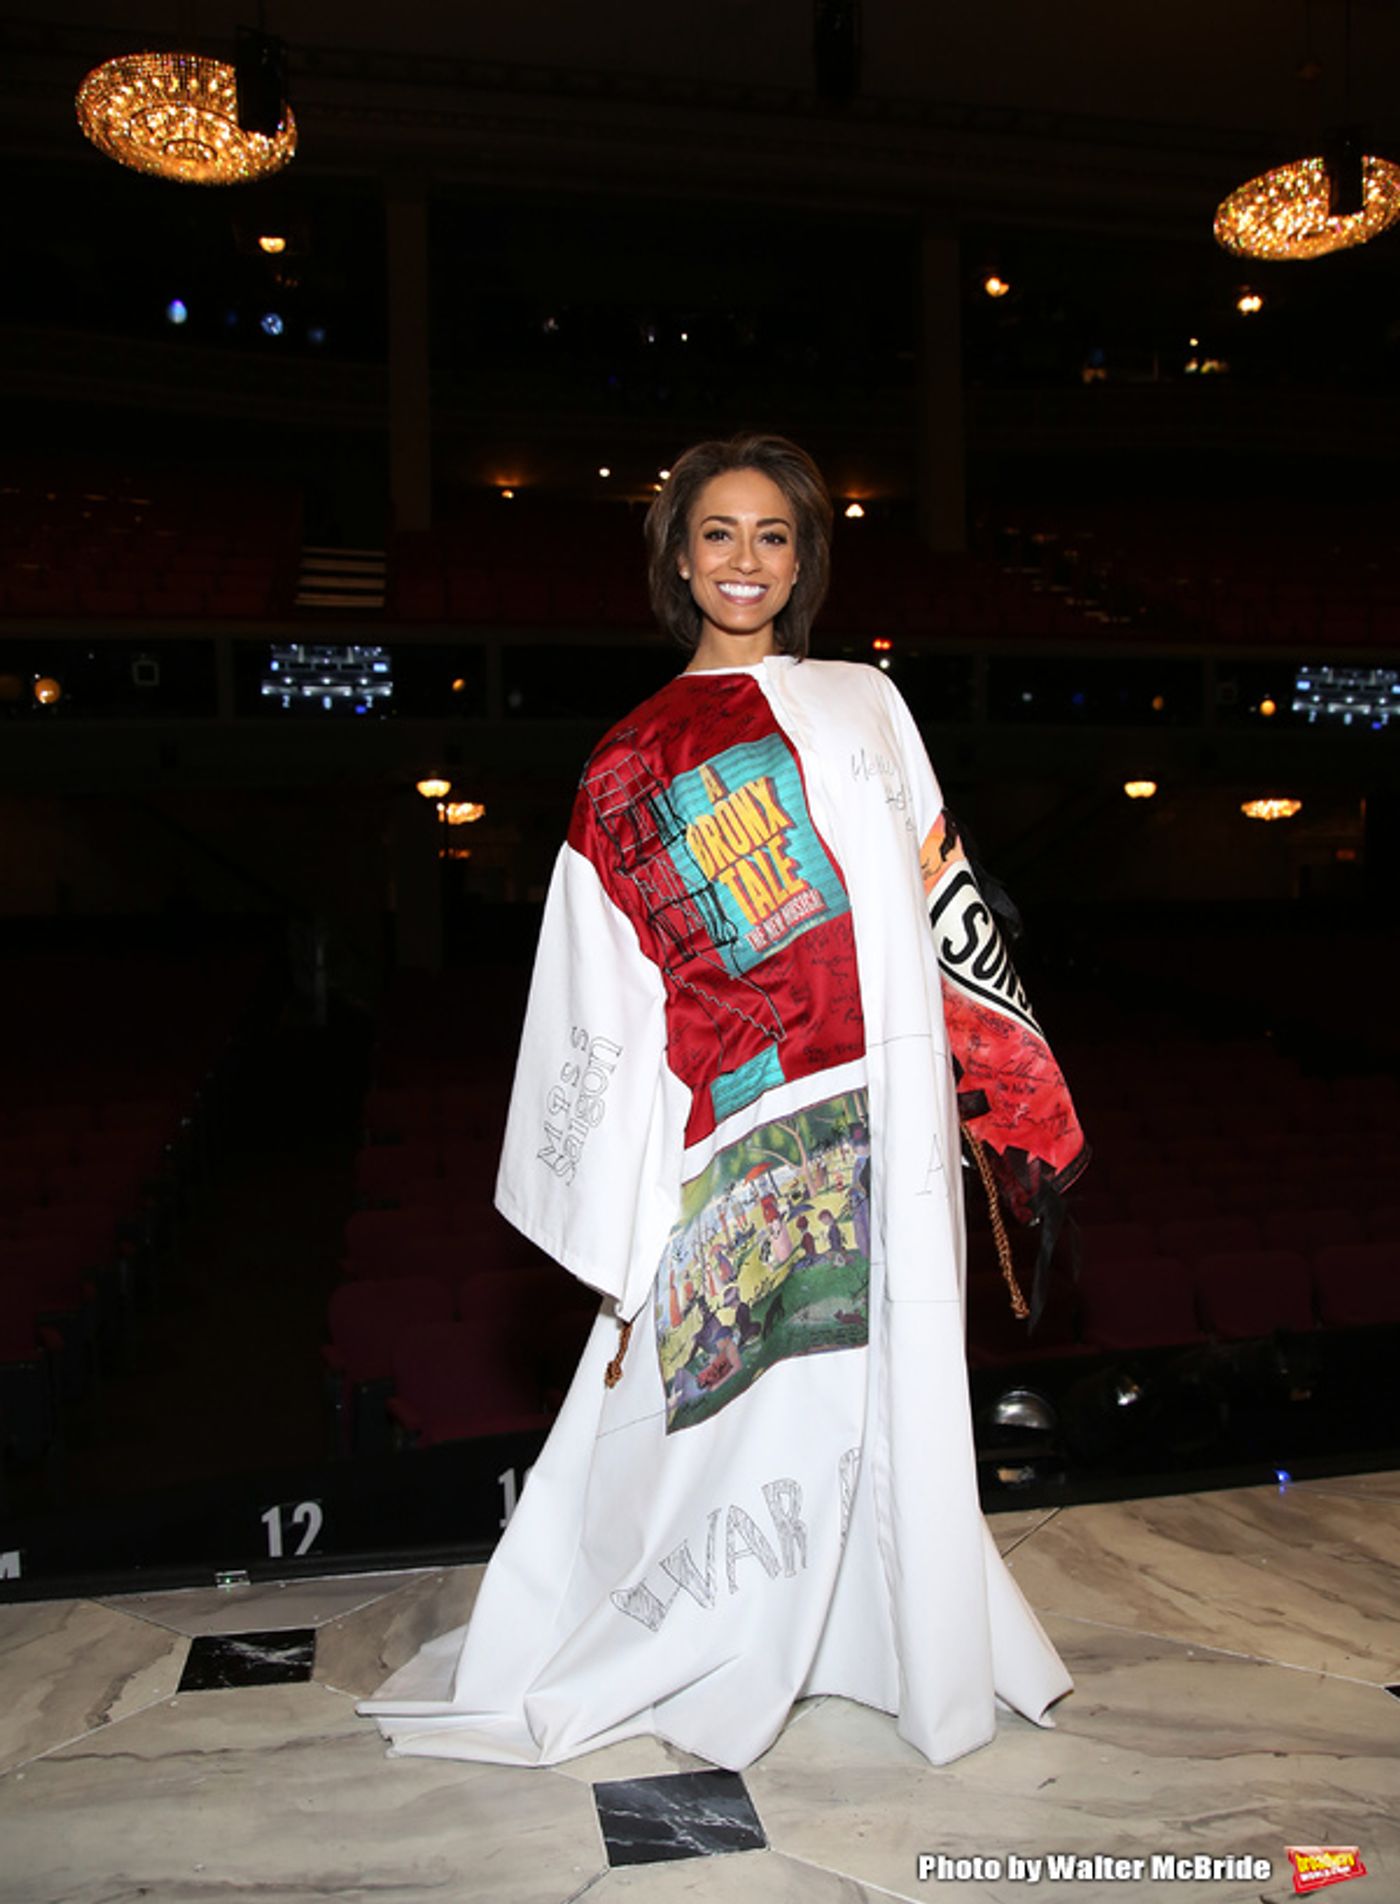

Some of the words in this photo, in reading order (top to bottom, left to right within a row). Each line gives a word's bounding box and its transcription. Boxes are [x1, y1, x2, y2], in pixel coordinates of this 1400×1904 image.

[686, 776, 798, 883] BRONX
[699, 763, 731, 804] A
[719, 833, 812, 927] TALE
[261, 1501, 323, 1558] 12
[609, 1478, 809, 1632] WAR
